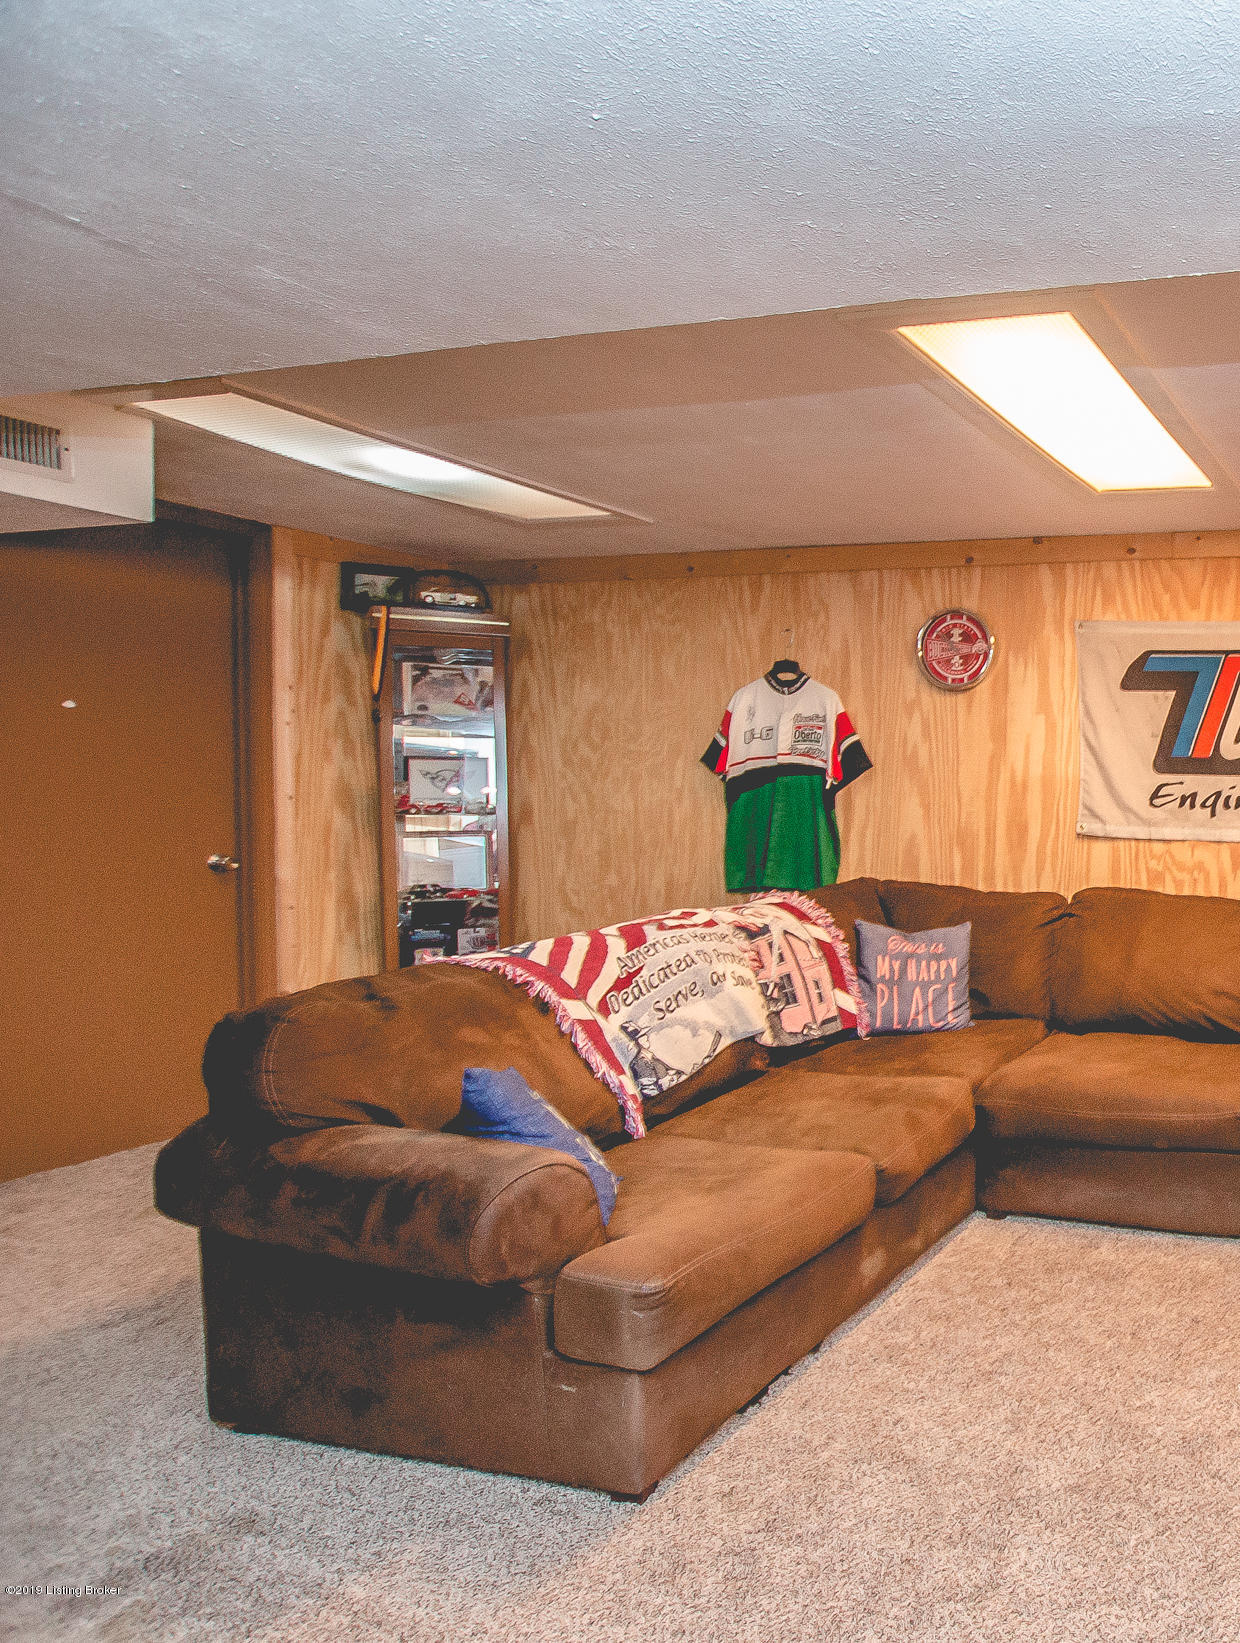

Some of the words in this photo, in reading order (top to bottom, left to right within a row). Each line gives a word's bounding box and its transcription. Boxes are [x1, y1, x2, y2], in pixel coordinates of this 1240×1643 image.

[793, 729, 822, 741] Oberto
[929, 942, 946, 954] is
[606, 952, 698, 1014] Dedicated
[876, 954, 901, 981] MY
[907, 956, 958, 982] HAPPY
[652, 980, 705, 1020] Serve,
[875, 981, 958, 1030] PLACE
